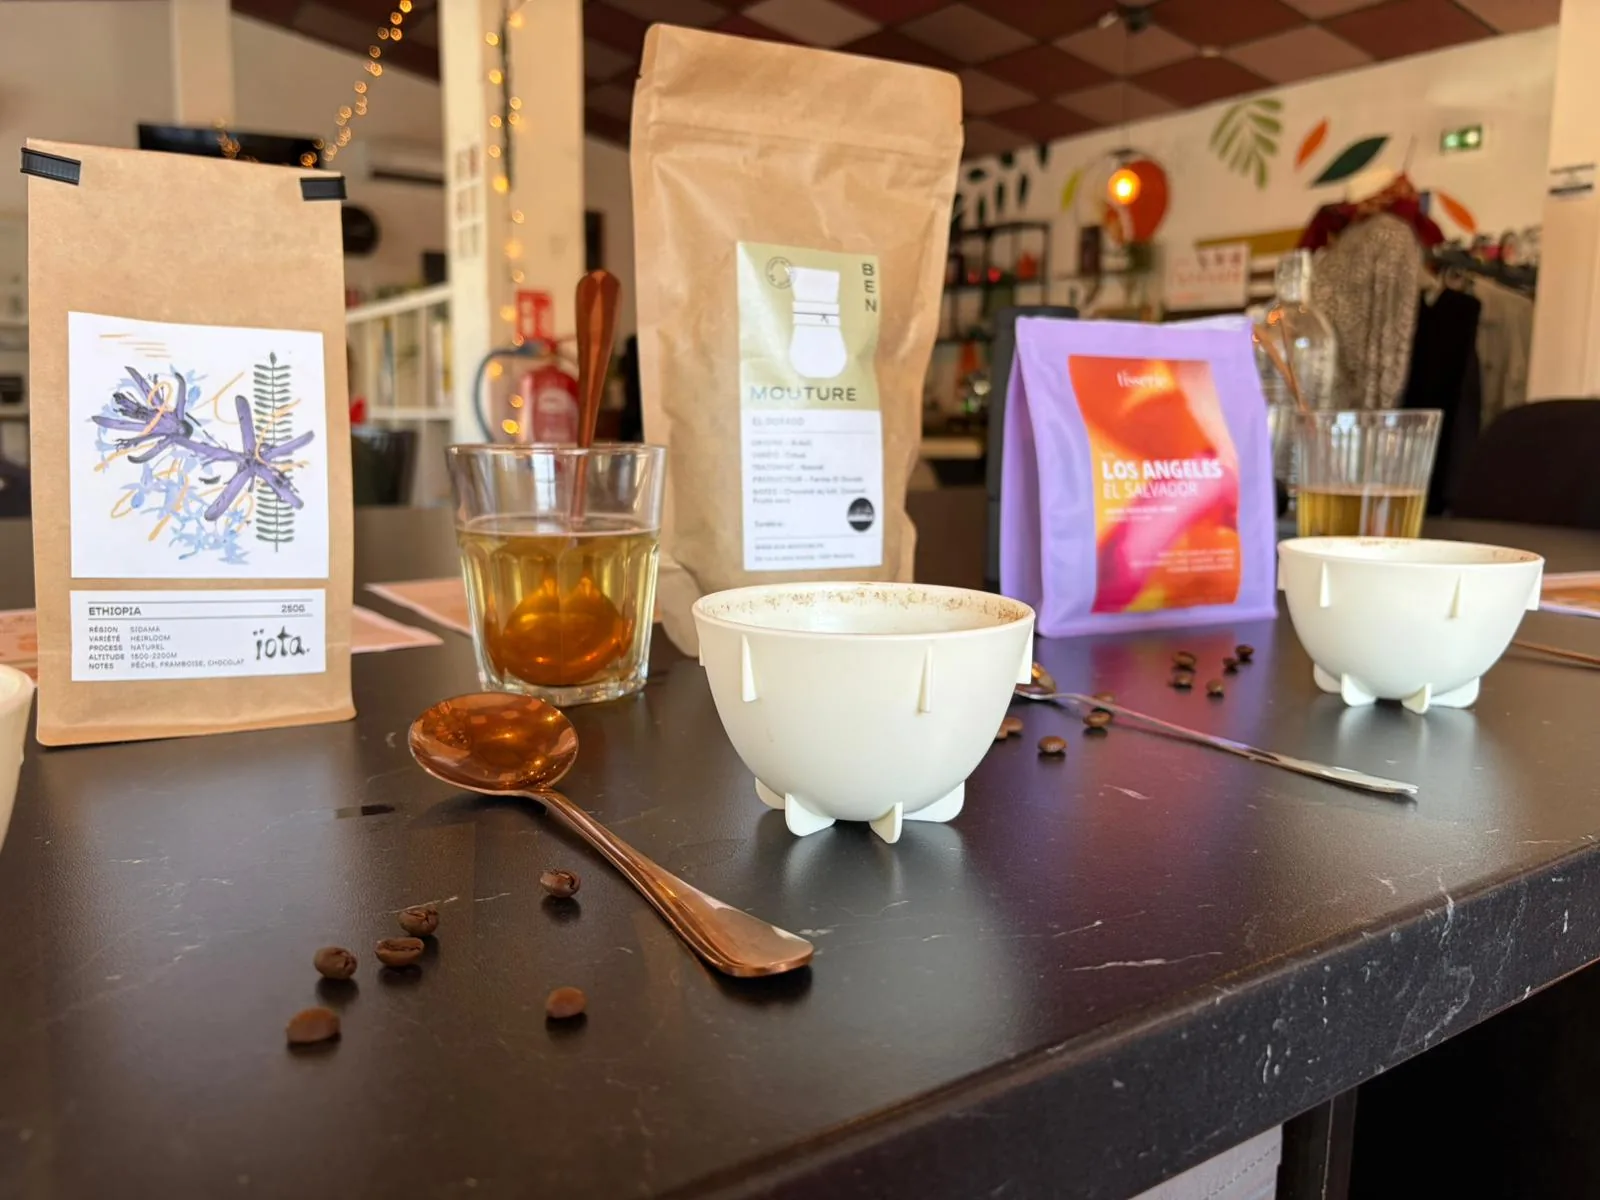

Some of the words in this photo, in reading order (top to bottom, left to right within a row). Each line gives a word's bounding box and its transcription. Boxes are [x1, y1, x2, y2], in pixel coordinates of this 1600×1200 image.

[862, 263, 877, 312] BEN
[751, 386, 857, 401] MOUTURE
[1102, 460, 1139, 480] LOS
[1142, 458, 1224, 480] ANGELES
[1103, 481, 1121, 499] EL
[1124, 481, 1198, 499] SALVADOR
[88, 606, 142, 616] ETHIOPIA
[88, 625, 119, 633] RÉGION
[130, 625, 161, 633] SIDAMA
[88, 634, 121, 642] VARIÉTÉ
[130, 634, 171, 642] HEIRLOOM
[130, 643, 165, 651] NATUREL
[88, 653, 125, 661] ALTITUDE
[88, 662, 114, 670] NOTES
[207, 657, 245, 667] CHOCOLAT
